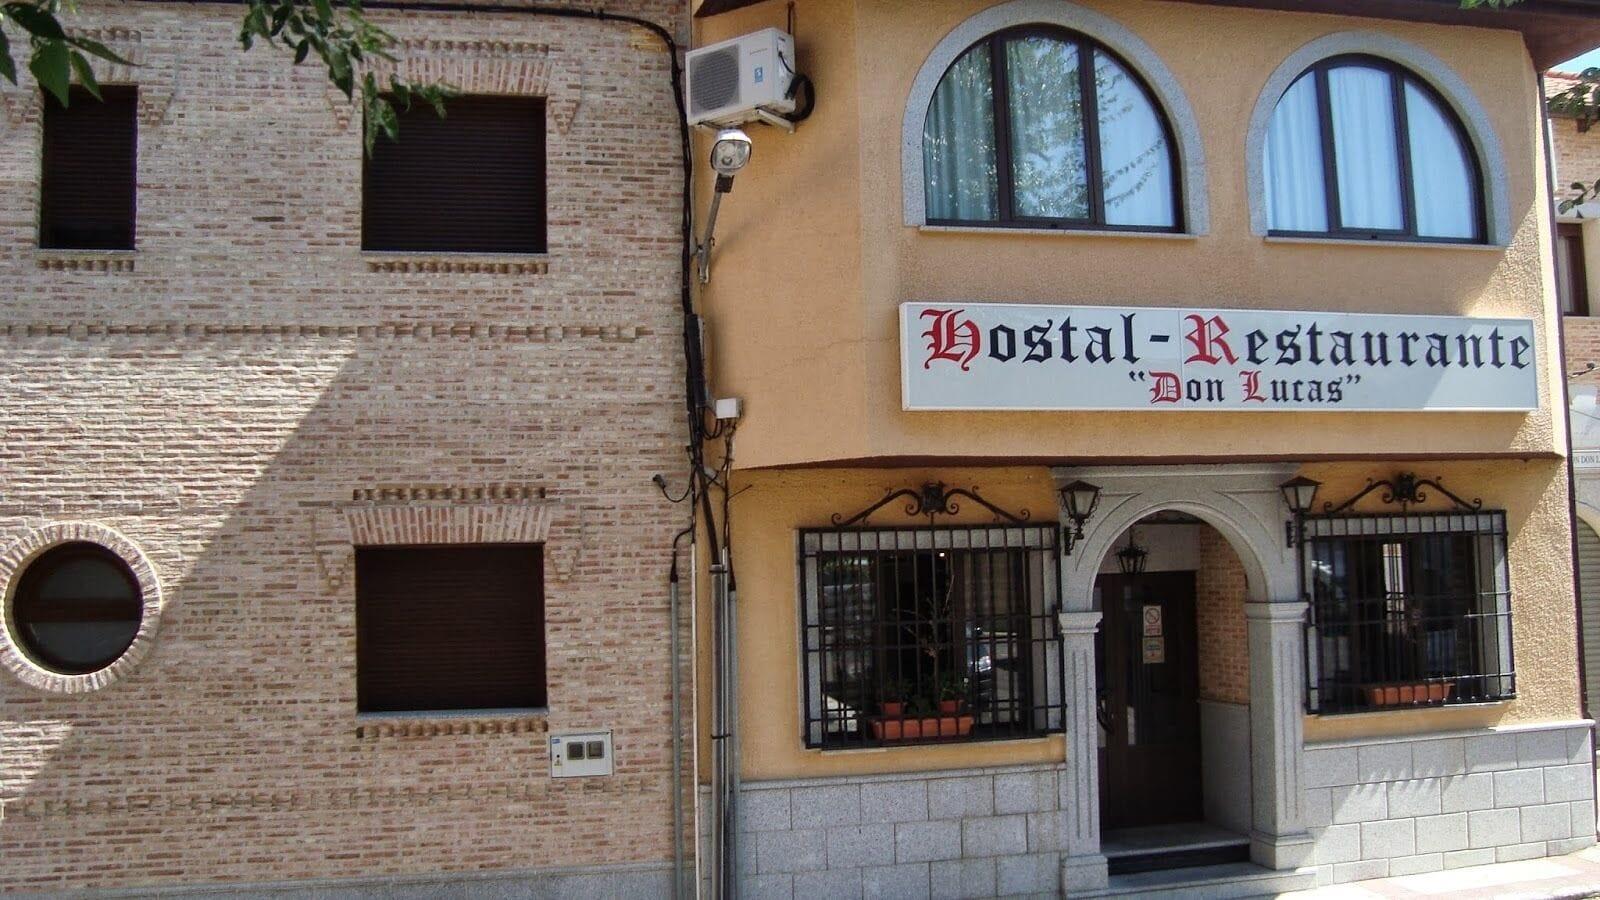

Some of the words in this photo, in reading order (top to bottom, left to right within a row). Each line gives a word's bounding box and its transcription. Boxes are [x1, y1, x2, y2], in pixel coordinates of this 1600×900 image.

[919, 308, 1141, 371] Hostal
[1184, 314, 1531, 369] Restaurante
[1581, 455, 1595, 464] DON
